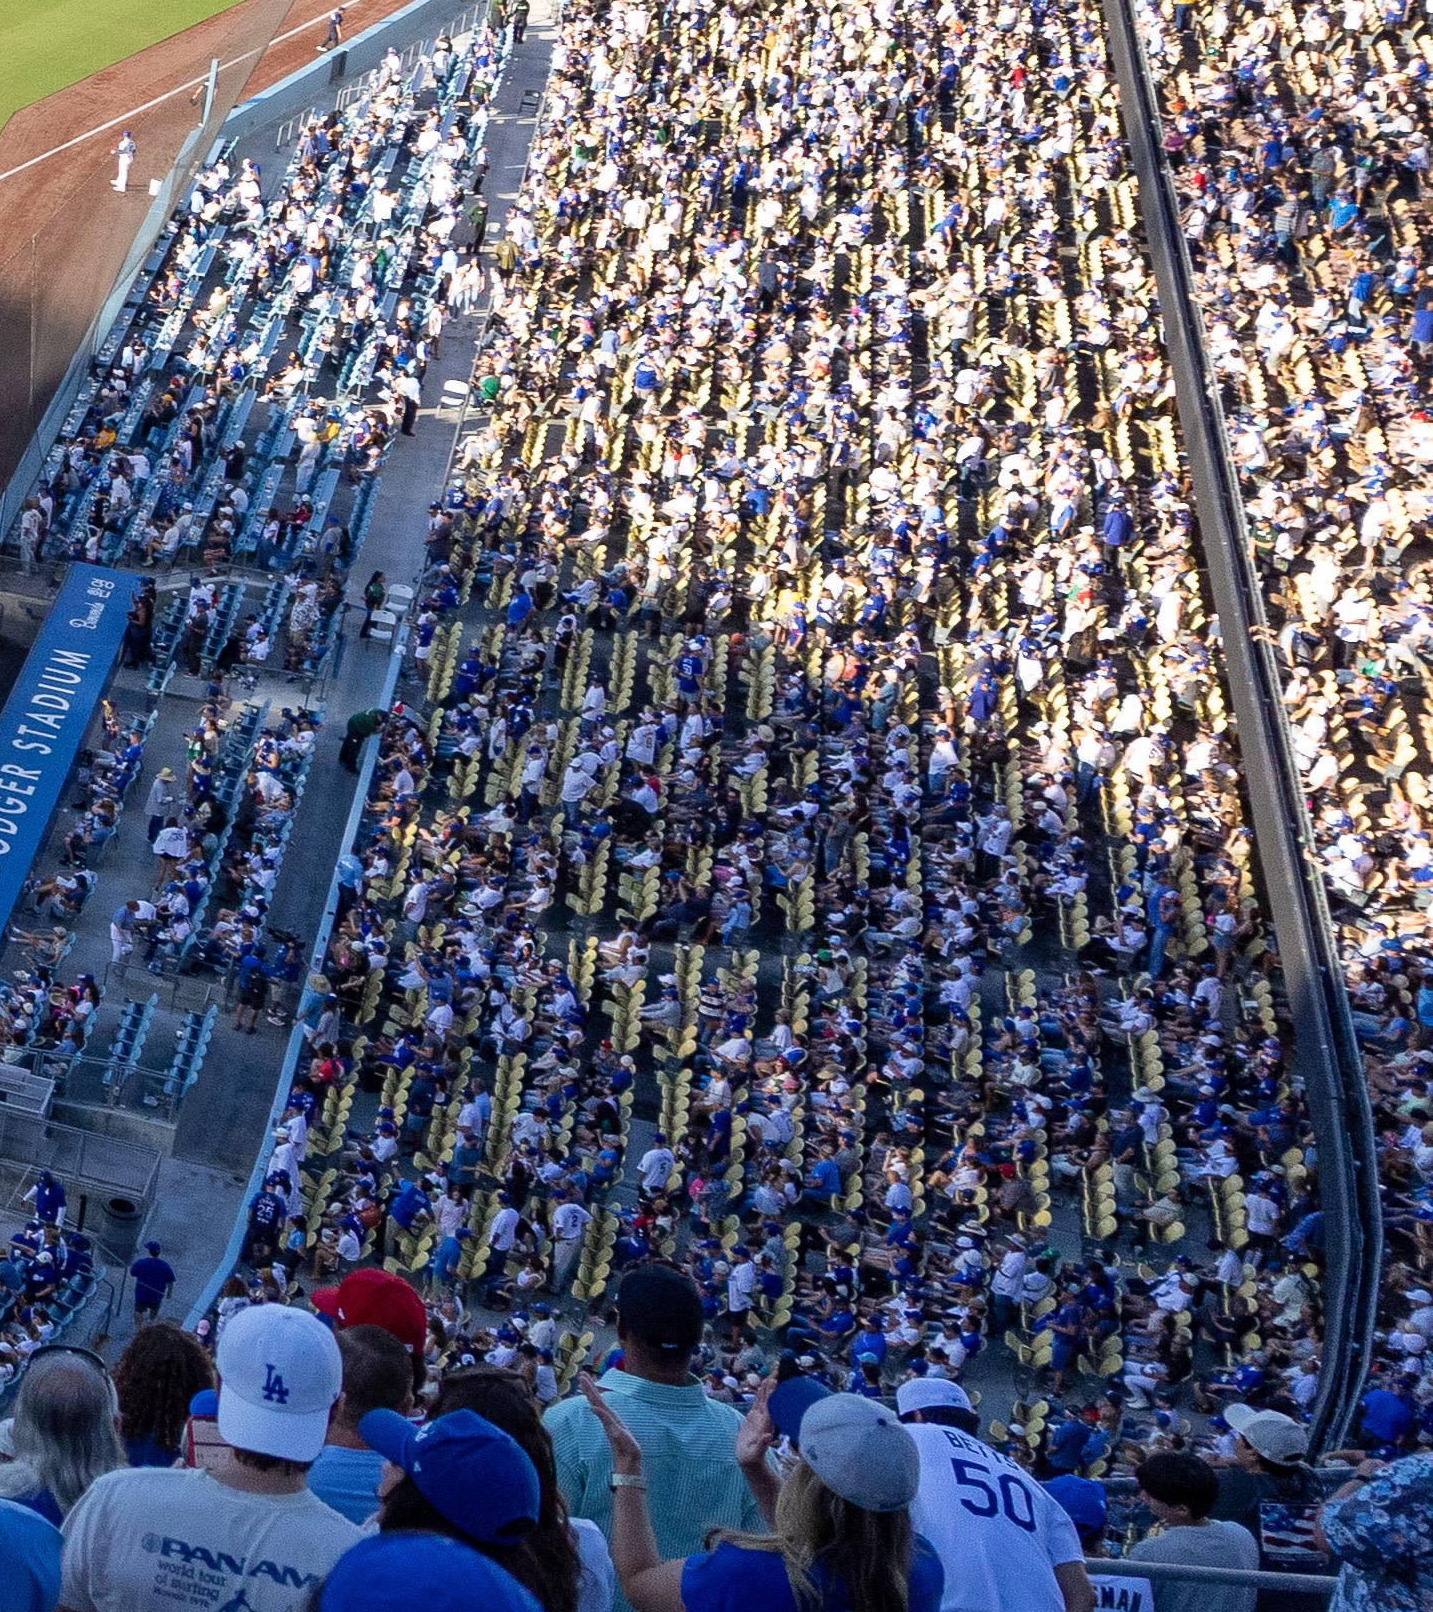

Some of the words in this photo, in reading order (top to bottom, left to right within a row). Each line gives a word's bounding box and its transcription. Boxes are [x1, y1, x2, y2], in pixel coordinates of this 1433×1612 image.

[12, 648, 92, 755] STADIUM
[262, 1364, 290, 1405] LA
[942, 1429, 1019, 1472] BETTS
[951, 1457, 1037, 1533] 50
[154, 1574, 167, 1586] of
[157, 1561, 196, 1579] world
[200, 1572, 227, 1588] tour
